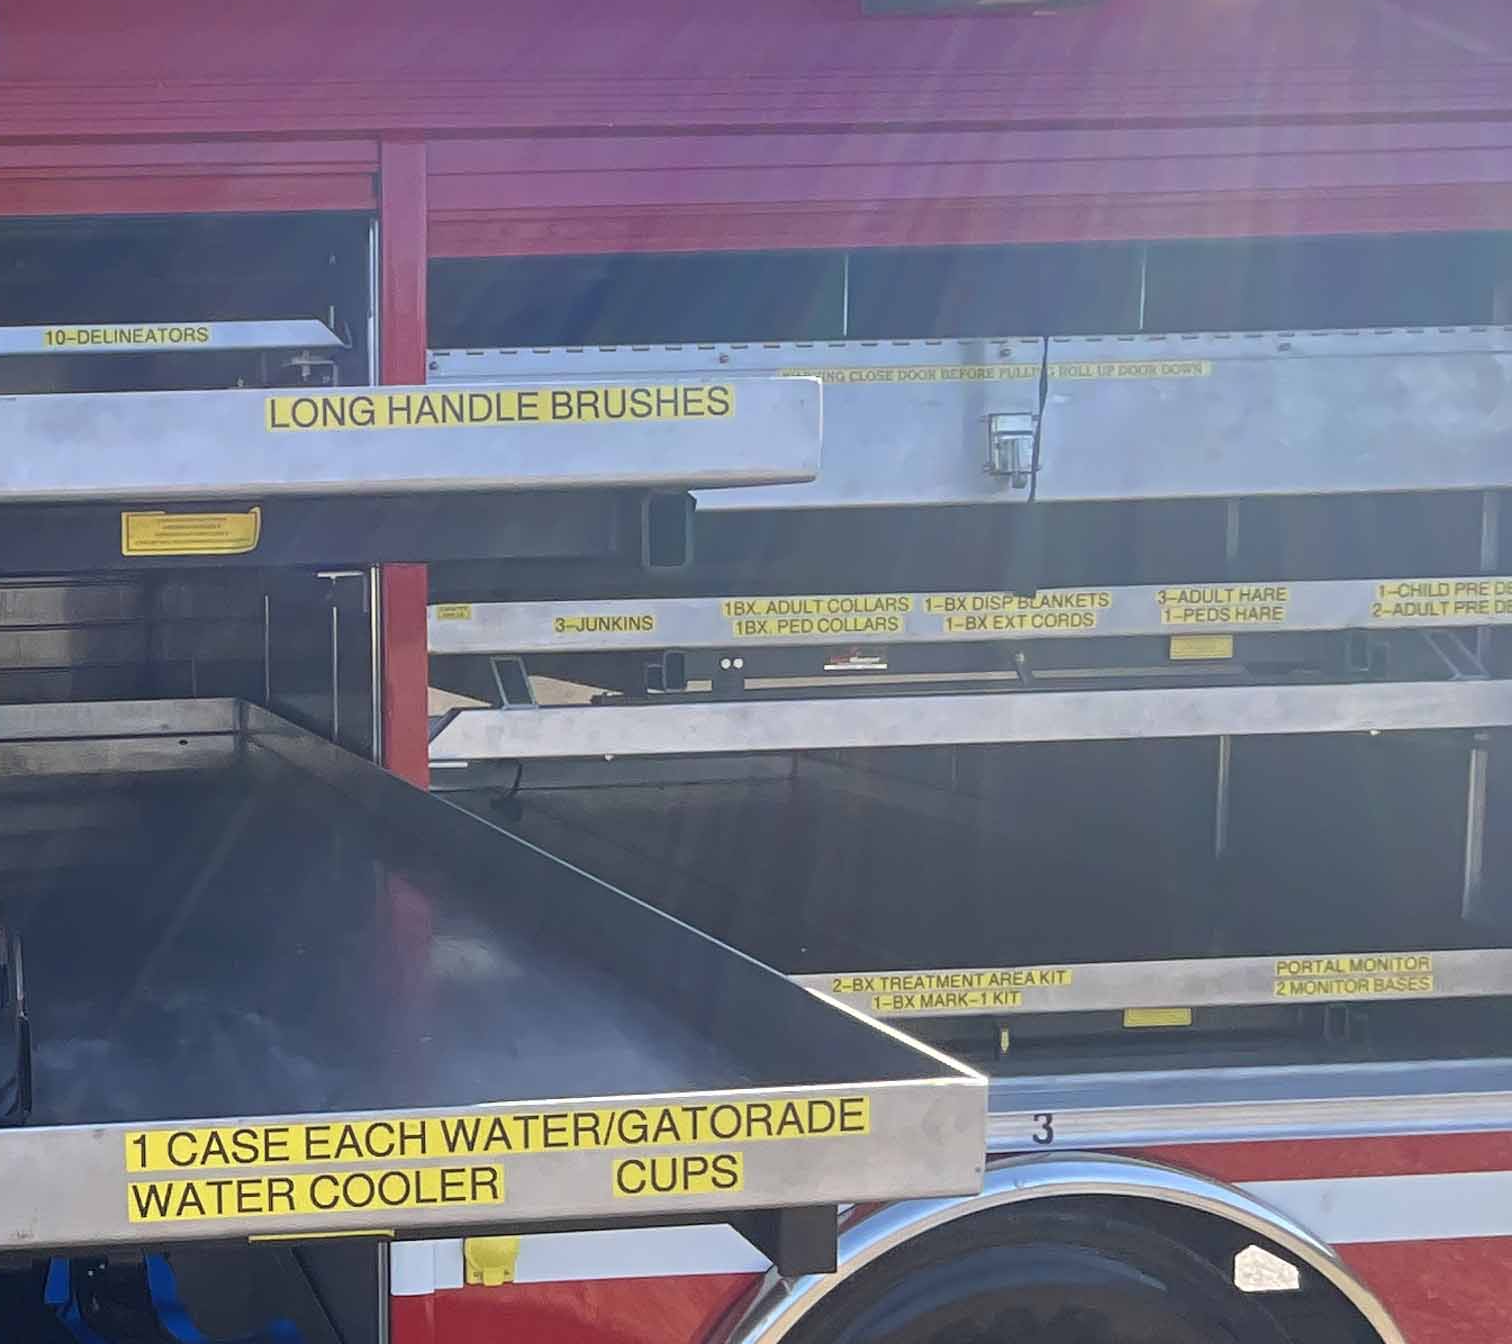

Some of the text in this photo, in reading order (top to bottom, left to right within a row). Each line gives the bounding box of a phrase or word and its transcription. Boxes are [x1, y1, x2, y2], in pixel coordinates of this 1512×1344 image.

[45, 327, 210, 346] 10-DELINEATORS
[270, 386, 730, 428] LONG HANDLE BRUSHES
[1157, 586, 1289, 605] 3-ADULT HARE
[1379, 582, 1450, 598] 1-CHILD
[1454, 581, 1489, 596] PRE
[766, 599, 821, 615] ADULT
[827, 597, 910, 613] COLLARS
[925, 592, 1110, 613] 1-BX DISP BLANKETS
[1372, 601, 1450, 618] 2-ADULT
[1454, 600, 1489, 614] PRE
[554, 615, 654, 633] 3-JUNKINS
[946, 612, 1095, 632] 1-BX EXT CORDS
[1164, 606, 1285, 623] 1-PEDS HARE
[777, 618, 814, 634] PED
[817, 616, 899, 633] COLLARS
[1276, 956, 1430, 976] PORTAL MONITOR
[832, 970, 1066, 993] 2-BX TREATMENT AREA KIT
[1276, 976, 1430, 996] 2 MONITOR BASES
[873, 990, 1020, 1009] 1-BX MARK-1 KIT
[133, 1096, 866, 1169] 1 CASE EACH WATER/GATORADE
[1032, 1112, 1054, 1145] 3
[615, 1153, 739, 1194] CUPS
[132, 1165, 500, 1219] WATER COOLER
